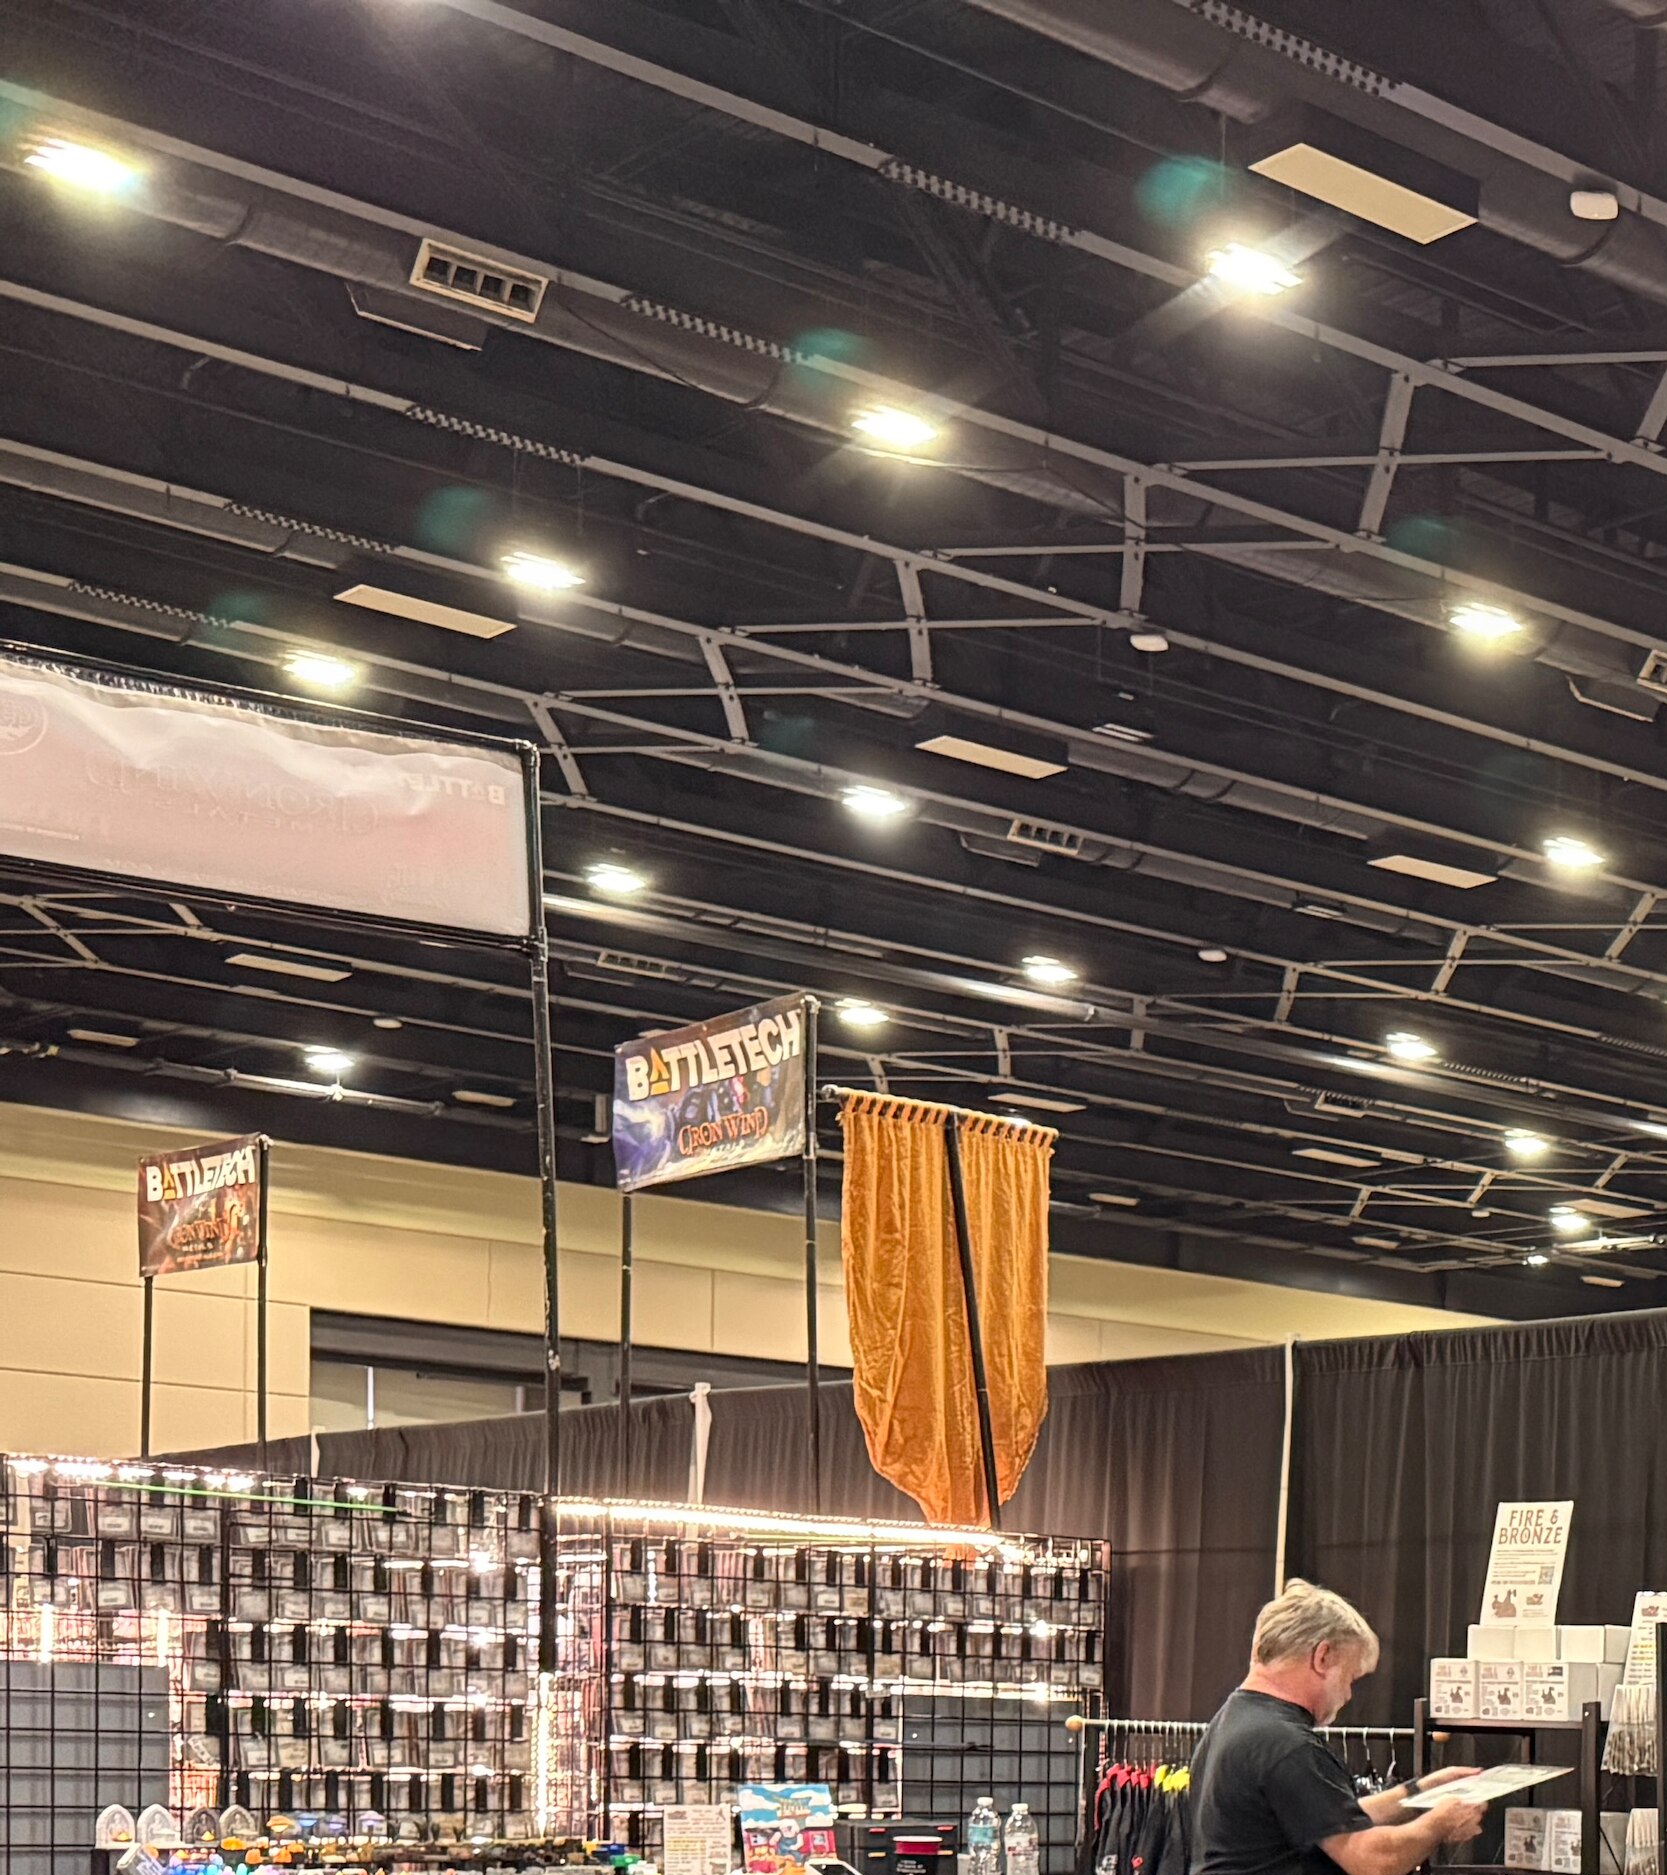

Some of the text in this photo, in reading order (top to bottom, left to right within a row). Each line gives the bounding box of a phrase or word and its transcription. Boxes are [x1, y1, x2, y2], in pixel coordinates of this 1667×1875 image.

[625, 1008, 802, 1101] BATTLETECH
[146, 1145, 256, 1202] BATTLETECH
[1498, 1527, 1563, 1545] BRONZE
[1509, 1509, 1559, 1527] FIRE &
